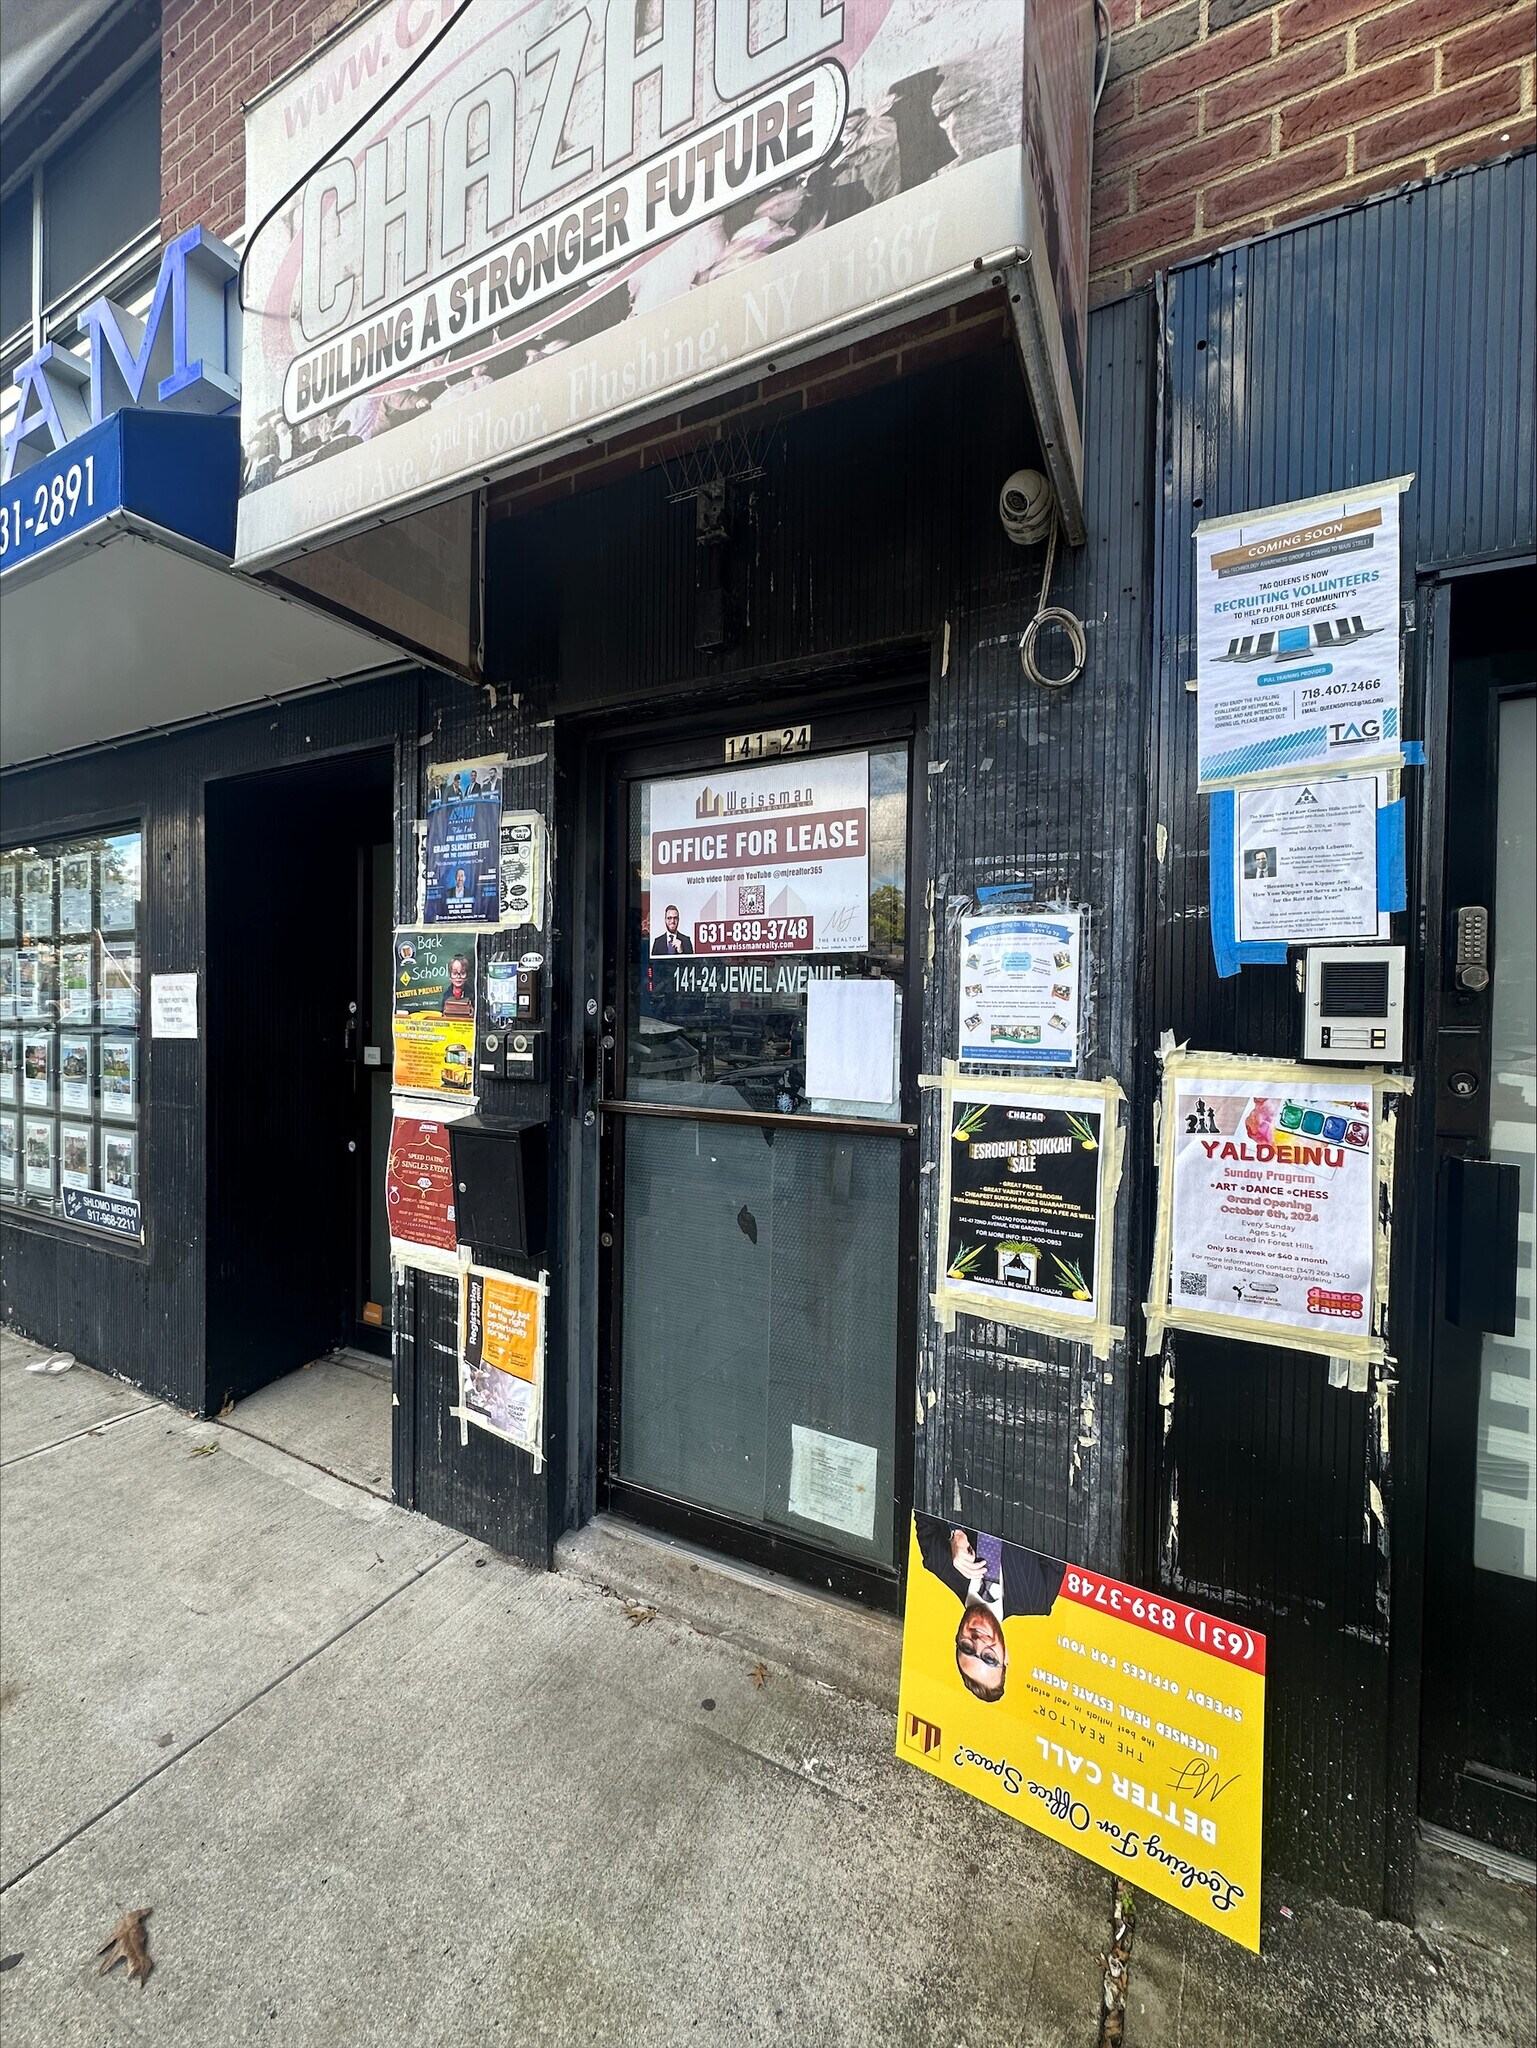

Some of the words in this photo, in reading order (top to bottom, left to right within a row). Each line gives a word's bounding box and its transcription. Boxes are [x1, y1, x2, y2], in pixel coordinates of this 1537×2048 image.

[296, 310, 413, 414] BUILDING
[420, 306, 442, 351] A
[448, 186, 631, 338] STRONGER
[646, 80, 816, 234] FUTURE
[566, 319, 729, 423] Flushing,
[741, 268, 802, 350] NY
[820, 211, 942, 312] 11367
[1248, 535, 1301, 557] COMING
[1304, 523, 1343, 541] SOON
[1259, 583, 1272, 591] TAG
[1273, 576, 1301, 588] QUEENS
[1311, 570, 1329, 580] NOW
[1214, 590, 1289, 614] RECRUITING
[1293, 570, 1379, 598] VOLUNTEERS
[1244, 608, 1261, 618] HELP
[1263, 603, 1289, 615] FULFILL
[1291, 600, 1304, 608] THE
[1306, 589, 1357, 605] COMMUNITY'S
[1251, 617, 1269, 626] NEED
[1271, 614, 1284, 622] FOR
[1286, 611, 1300, 619] OUR
[1302, 603, 1338, 617] SERVICES.
[1302, 679, 1381, 700] 718.407.2466
[1330, 720, 1380, 741] TAG
[728, 727, 808, 761] 141-24
[727, 787, 813, 810] Weissman
[474, 841, 490, 849] EVENT
[658, 834, 728, 865] OFFICE
[736, 829, 777, 857] FOR
[786, 819, 859, 852] LEASE
[687, 876, 705, 885] Watch
[706, 875, 722, 884] video
[724, 873, 735, 882] tour
[747, 870, 771, 880] YouTube
[773, 866, 823, 879] @mjrealtor365
[700, 918, 807, 943] 631-839-3748
[417, 934, 443, 950] Back
[711, 941, 794, 952] www.weissmanrealty.com
[412, 963, 448, 980] School
[674, 966, 717, 993] 141-24
[721, 965, 773, 993] JEWEL
[1008, 1110, 1044, 1122] CHAZAQ
[973, 1141, 1018, 1159] ESROGIM
[1018, 1140, 1028, 1156] &
[1028, 1136, 1072, 1154] SUKKAH
[1201, 1140, 1345, 1167] YALDEINU
[402, 1161, 429, 1170] SINGLES
[430, 1164, 449, 1174] EVENT
[1011, 1156, 1036, 1173] SALE
[1224, 1167, 1263, 1181] Sunday
[1266, 1170, 1315, 1184] Program
[83, 1196, 110, 1211] SHLOMO
[1220, 1205, 1265, 1217] October
[1291, 1212, 1319, 1222] 2024
[1227, 1195, 1261, 1206] Grand
[1263, 1198, 1312, 1212] Opening
[87, 1209, 135, 1231] 917-968-2211
[1241, 1220, 1263, 1229] Every
[1265, 1222, 1296, 1232] Sunday
[988, 1231, 1005, 1239] MORE
[1006, 1233, 1021, 1241] INFO:
[1225, 1234, 1256, 1243] Located
[1268, 1239, 1294, 1248] Forest
[1296, 1242, 1313, 1250] Hills
[1249, 1229, 1269, 1237] Ages
[1271, 1231, 1287, 1239] 5-14
[1207, 1244, 1224, 1252] Only
[1245, 1248, 1266, 1257] week
[1277, 1252, 1293, 1260] $40
[1301, 1257, 1328, 1265] month
[1204, 1255, 1223, 1263] more
[1223, 1257, 1265, 1268] information
[1266, 1263, 1295, 1273] contact:
[1296, 1267, 1315, 1275] (347)
[1316, 1269, 1350, 1279] 269-1340
[1207, 1262, 1223, 1270] Sign
[1234, 1265, 1256, 1275] today:
[1257, 1269, 1332, 1284] Chazaq.org/yaldeinu
[1309, 1288, 1361, 1301] dance
[1309, 1296, 1362, 1309] dance
[469, 1281, 479, 1345] Registration
[1309, 1304, 1361, 1317] dance
[1067, 1572, 1177, 1630] 839-3748
[1057, 1634, 1087, 1656] YOU!
[1184, 1609, 1255, 1660] (631)
[1091, 1647, 1117, 1669] FOR
[1031, 1666, 1069, 1691] AGENT
[1122, 1661, 1180, 1696] OFFICES
[1026, 1683, 1051, 1698] estate
[1071, 1686, 1114, 1713] ESTATE
[1054, 1696, 1071, 1710] real
[1074, 1703, 1082, 1713] in
[1186, 1687, 1243, 1723] SPEEDY
[1086, 1706, 1113, 1728] initials
[1119, 1703, 1152, 1729] REAL
[1117, 1725, 1137, 1741] best
[1143, 1734, 1156, 1748] the
[1155, 1721, 1219, 1760] LICENSED
[1035, 1735, 1103, 1785] CALL
[1116, 1740, 1145, 1763] THE
[953, 1745, 1024, 1794] Space?
[1027, 1780, 1091, 1831] Office
[1111, 1772, 1218, 1845] BETTER
[1095, 1818, 1140, 1859] For
[1143, 1835, 1245, 1911] Looking
